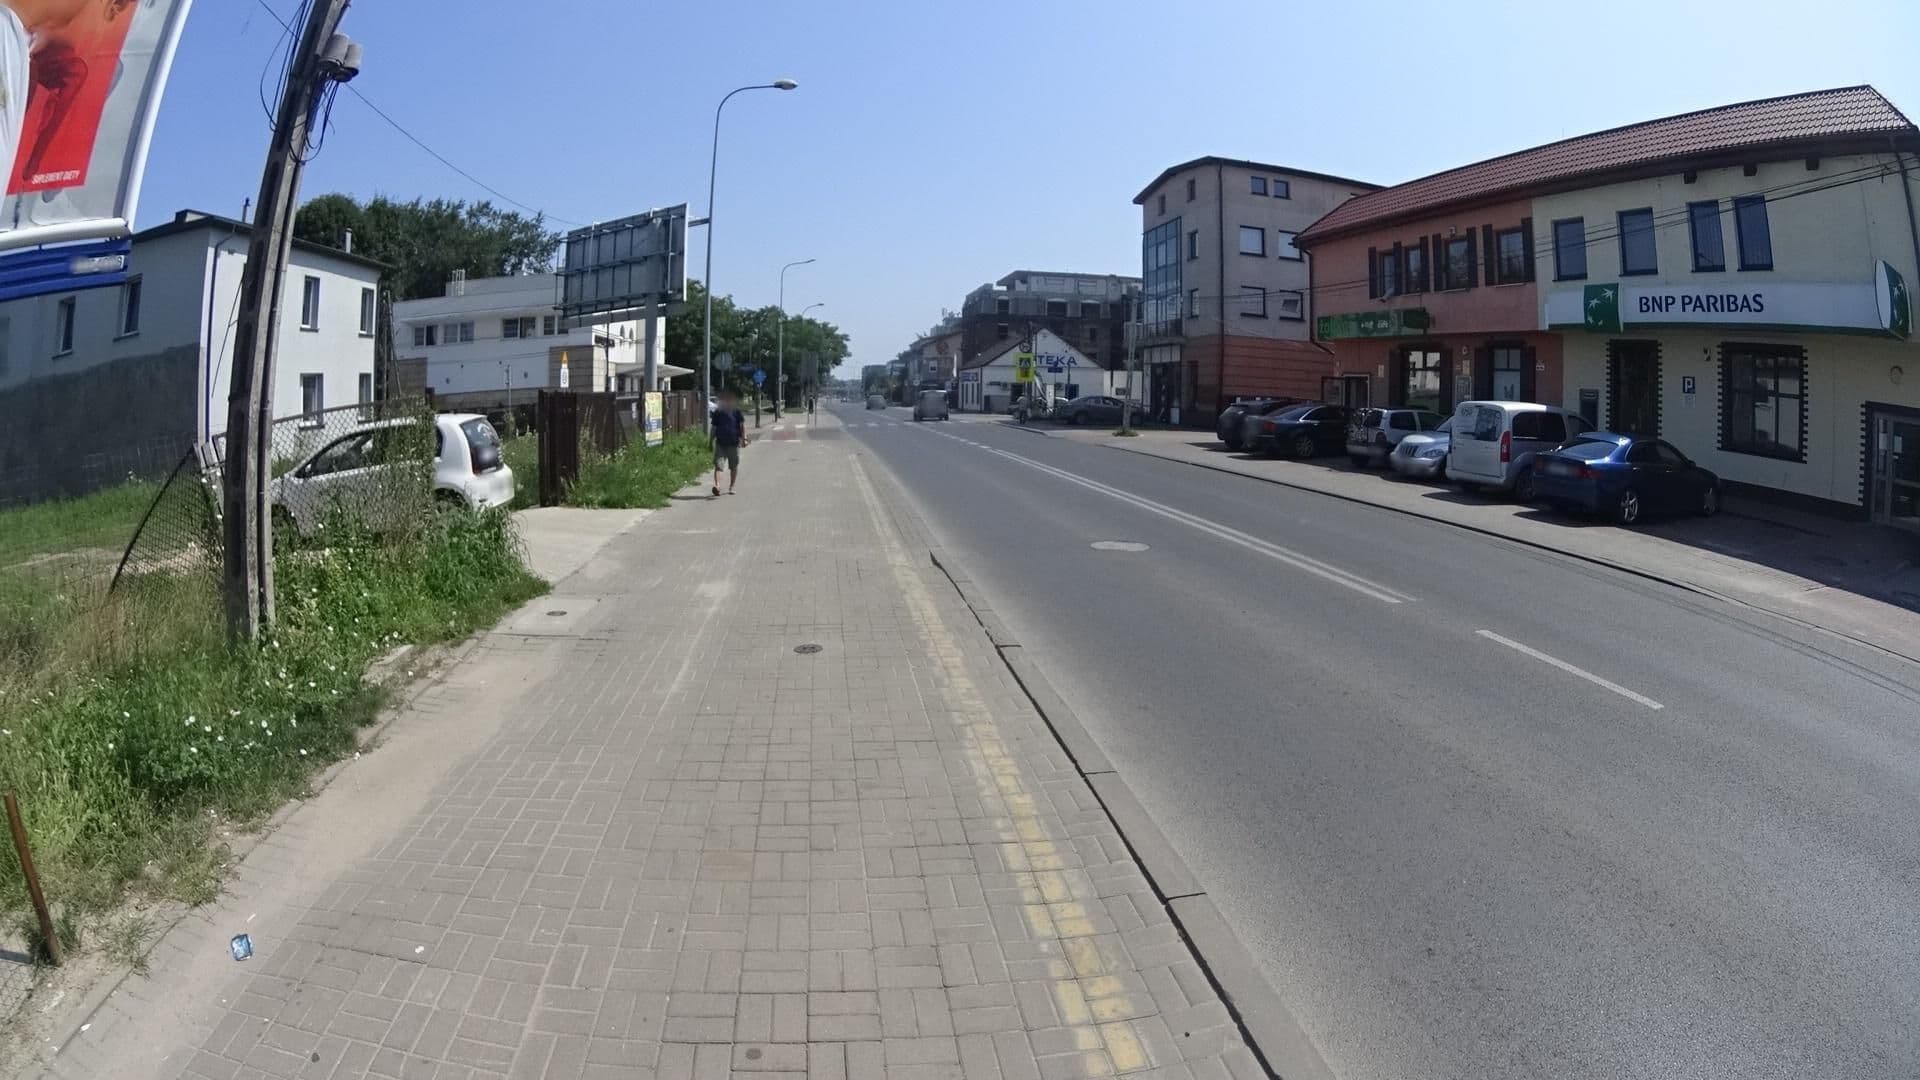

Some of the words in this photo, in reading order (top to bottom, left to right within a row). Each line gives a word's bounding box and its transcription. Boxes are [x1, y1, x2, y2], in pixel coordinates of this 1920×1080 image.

[1639, 295, 1676, 313] BNP
[1681, 293, 1764, 313] PARIBAS
[1037, 354, 1077, 366] TEKA
[1685, 377, 1693, 392] P
